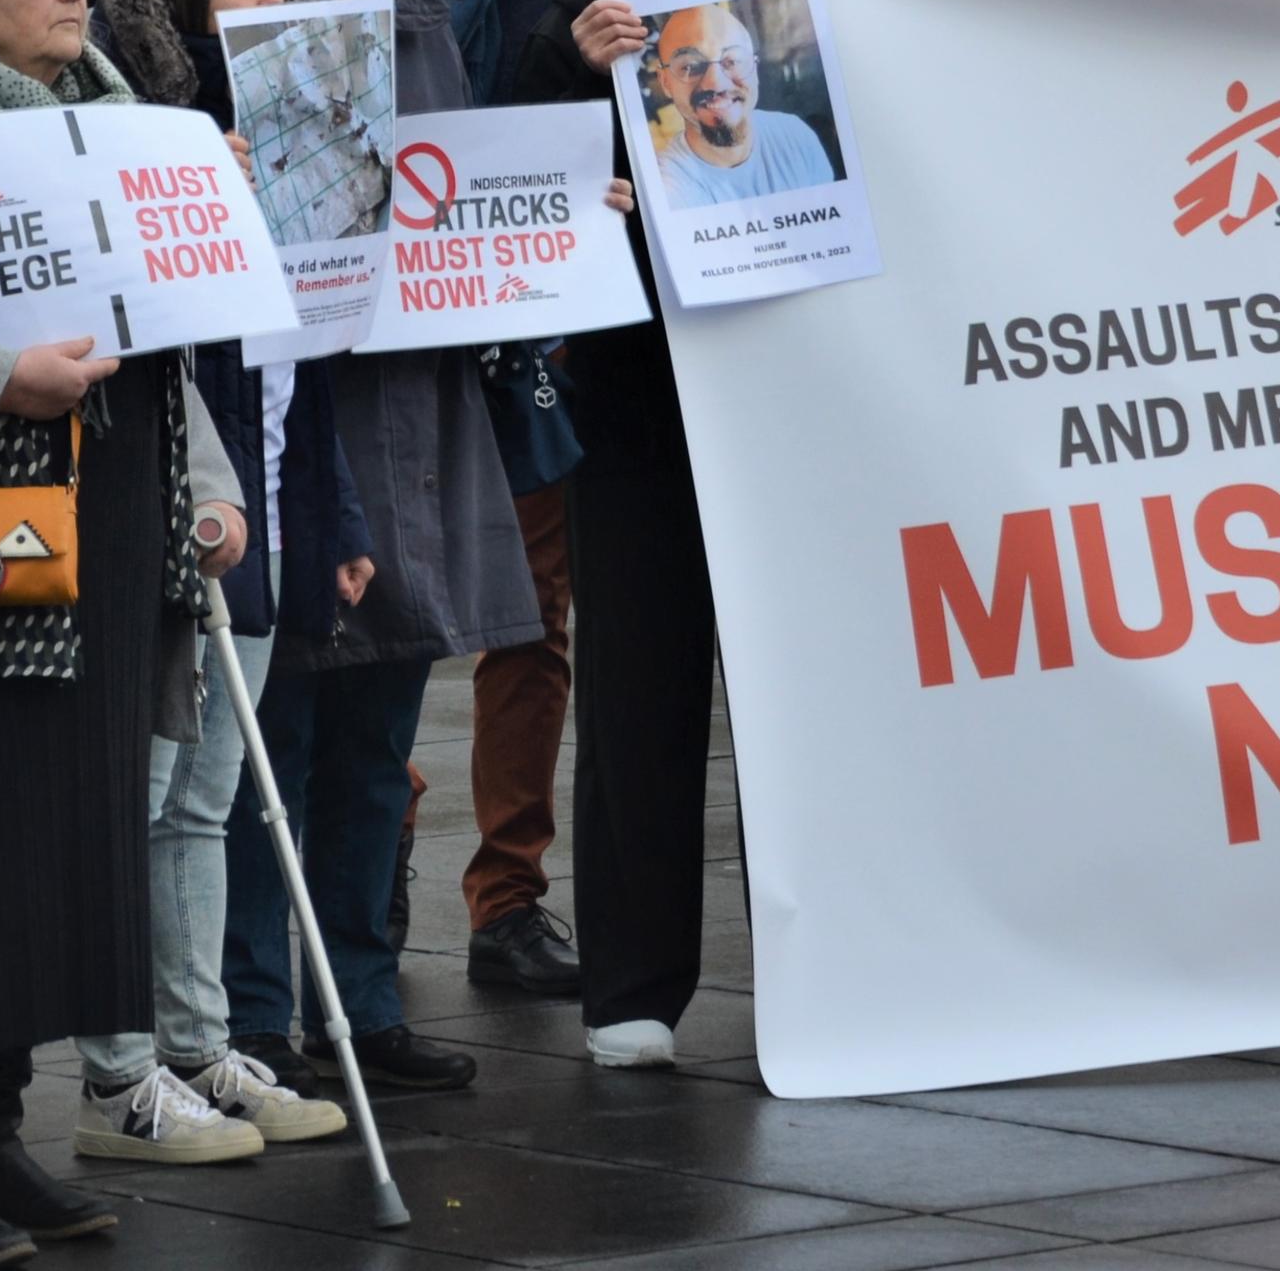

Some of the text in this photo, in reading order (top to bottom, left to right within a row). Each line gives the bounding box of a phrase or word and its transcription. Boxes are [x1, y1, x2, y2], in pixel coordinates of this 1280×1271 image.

[118, 166, 220, 203] MUST
[469, 171, 567, 190] INDISCRIMINATE
[135, 202, 230, 241] STOP
[432, 191, 571, 233] ATTACKS
[693, 205, 841, 244] ALAA AL SHAWA
[143, 239, 249, 284] NOW!
[298, 259, 317, 274] did
[320, 255, 348, 271] what
[350, 254, 365, 265] we
[394, 229, 577, 274] MUST STOP
[700, 265, 735, 279] KILLED
[736, 263, 752, 273] ON
[753, 253, 809, 271] NOVEMBER
[827, 245, 852, 258] 2023
[754, 240, 788, 254] NURSE
[295, 274, 355, 293] Remember
[398, 274, 489, 313] NOW!
[1058, 393, 1191, 469] AND
